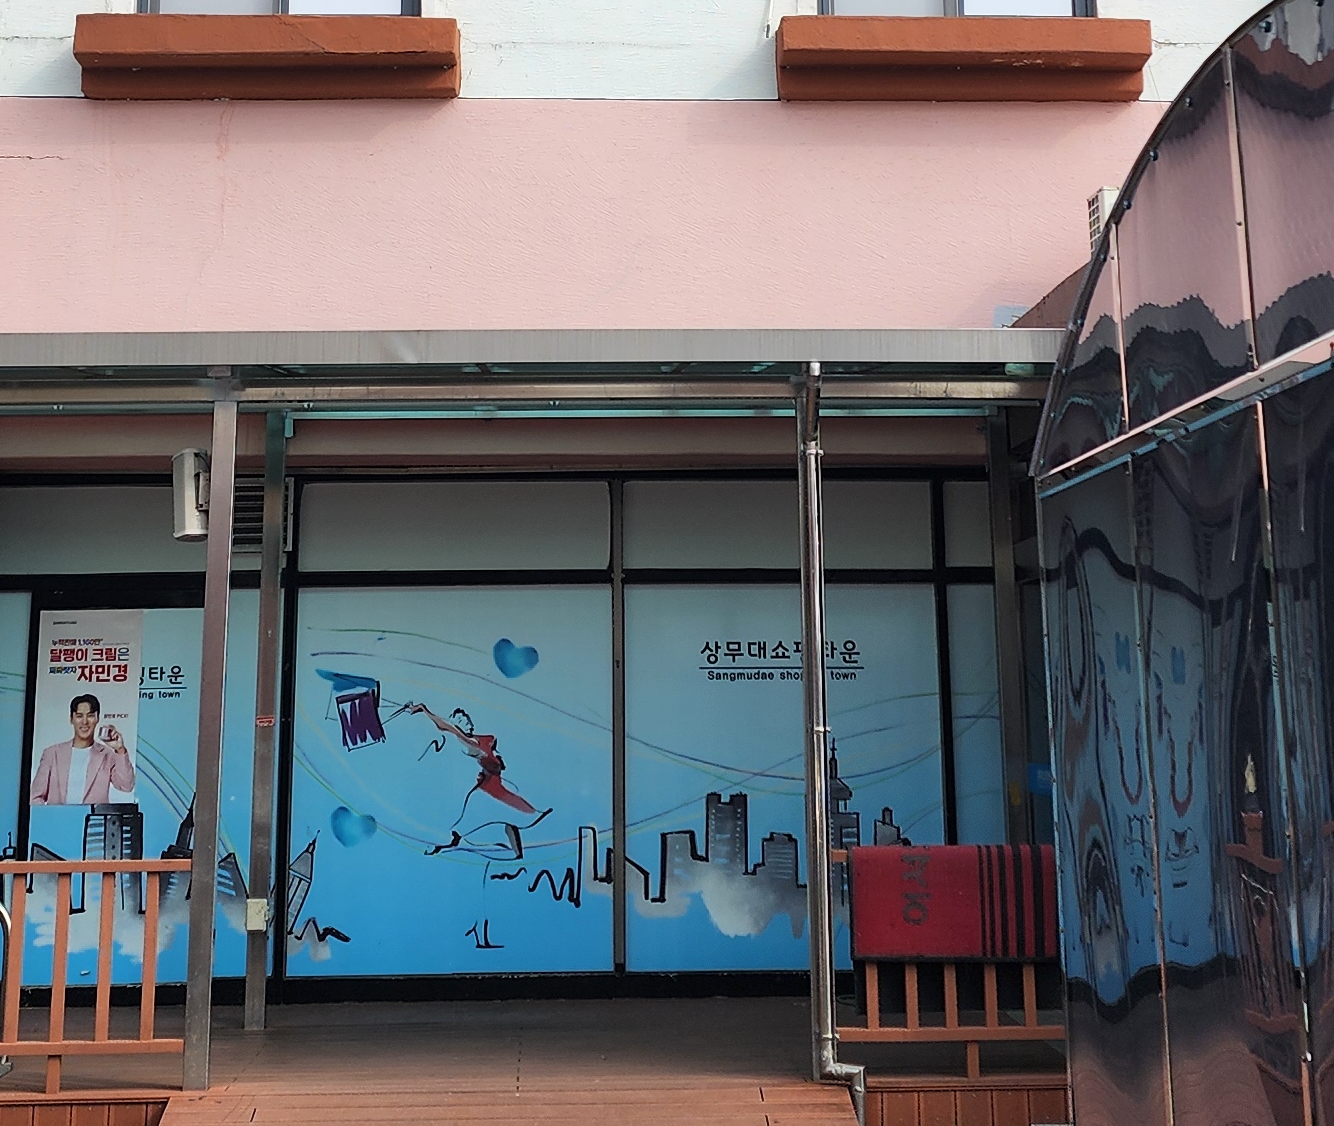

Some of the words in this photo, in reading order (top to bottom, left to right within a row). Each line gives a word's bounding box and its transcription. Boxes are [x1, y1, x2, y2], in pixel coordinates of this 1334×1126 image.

[49, 648, 88, 663] 달팽이
[91, 647, 129, 662] 크림은
[77, 663, 128, 683] 자민경
[707, 670, 775, 682] Sangmudae
[830, 670, 857, 681] town
[158, 690, 181, 699] town
